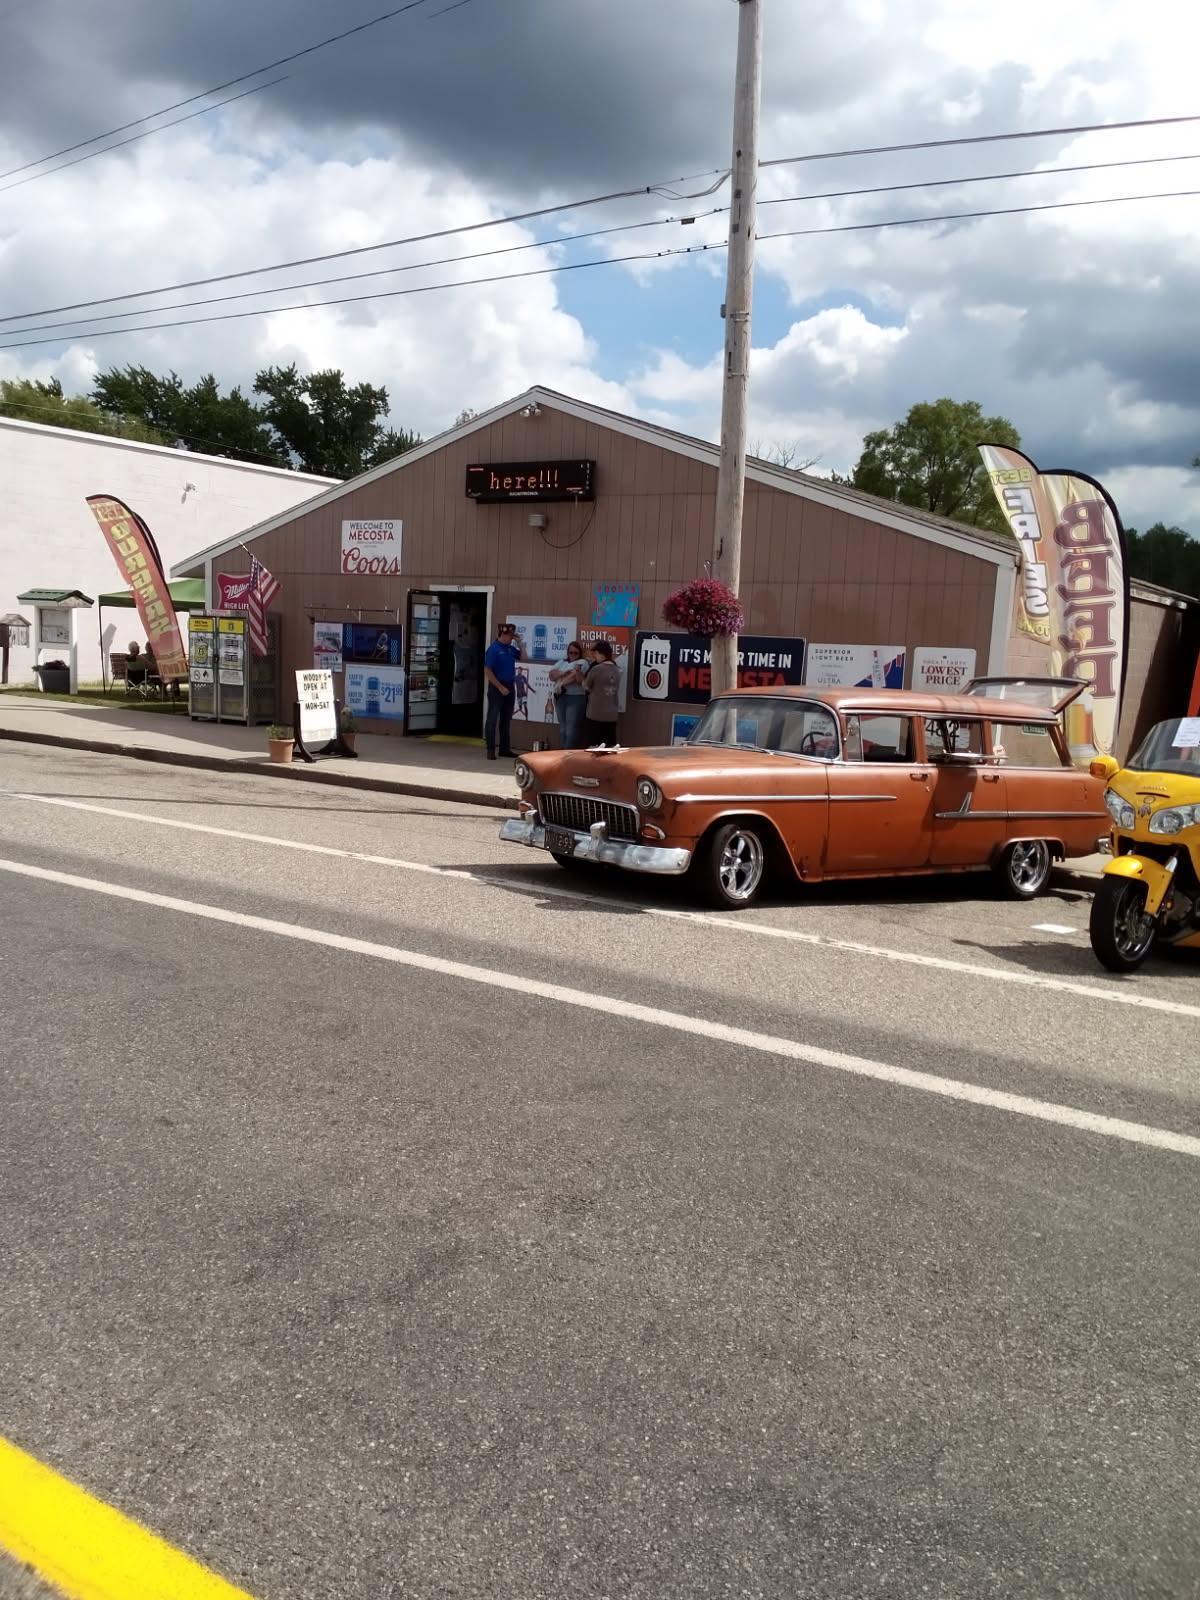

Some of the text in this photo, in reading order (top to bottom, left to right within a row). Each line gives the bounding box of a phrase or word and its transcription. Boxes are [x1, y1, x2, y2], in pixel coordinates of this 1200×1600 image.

[489, 469, 559, 489] here!!!
[350, 522, 394, 530] WELCOME TO
[349, 530, 394, 540] MECOSTA
[342, 547, 400, 576] Coors
[554, 627, 568, 635] EASY
[581, 630, 608, 641] RIGHT
[642, 649, 668, 668] Lite
[679, 648, 701, 663] IT'S
[747, 652, 775, 668] TIME
[778, 654, 792, 668] IN
[921, 665, 968, 675] LOWEST
[678, 667, 786, 690] MESTA
[926, 675, 960, 685] PRICE
[303, 683, 317, 691] OPEN
[305, 701, 330, 711] MON-SAT
